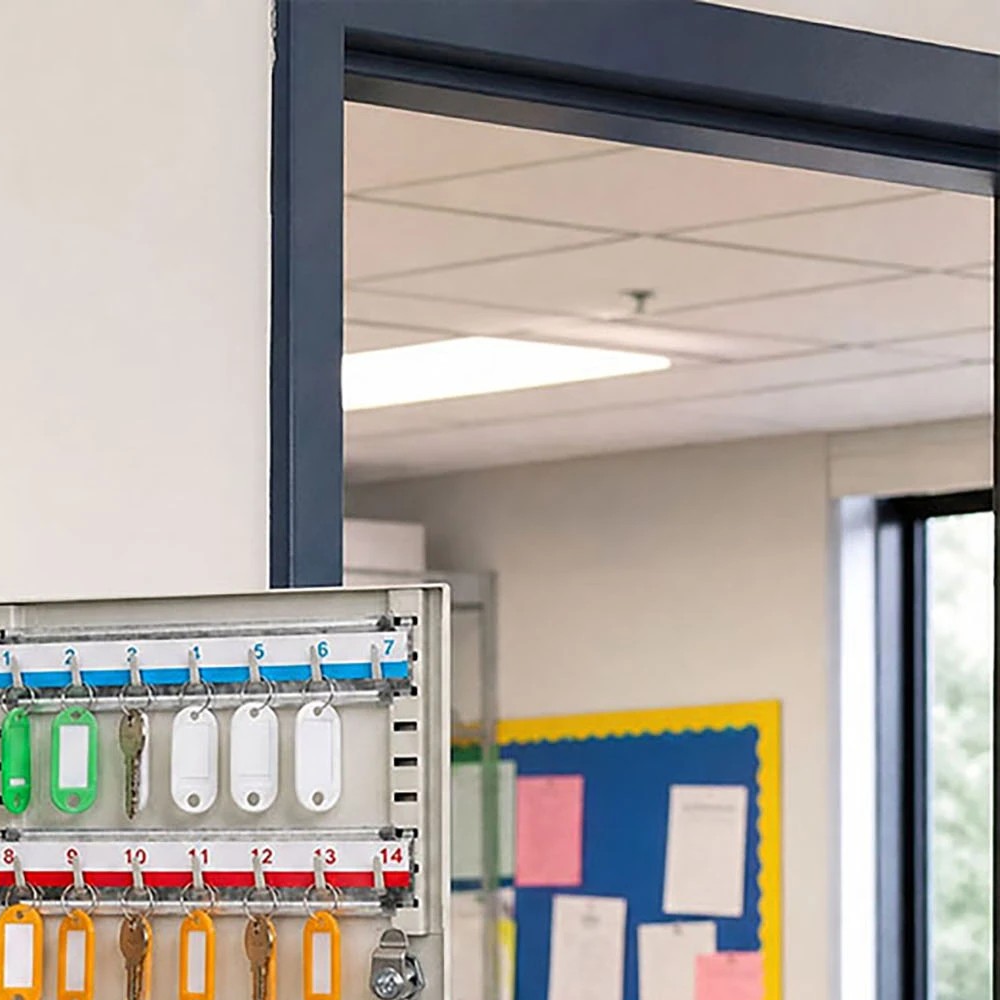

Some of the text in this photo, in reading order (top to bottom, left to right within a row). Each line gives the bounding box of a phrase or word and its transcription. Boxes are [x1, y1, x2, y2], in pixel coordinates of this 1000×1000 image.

[254, 643, 265, 660] 5
[318, 641, 328, 658] 6
[384, 639, 395, 655] 7
[3, 848, 14, 864] 8
[124, 848, 146, 864] 10
[380, 848, 404, 864] 14
